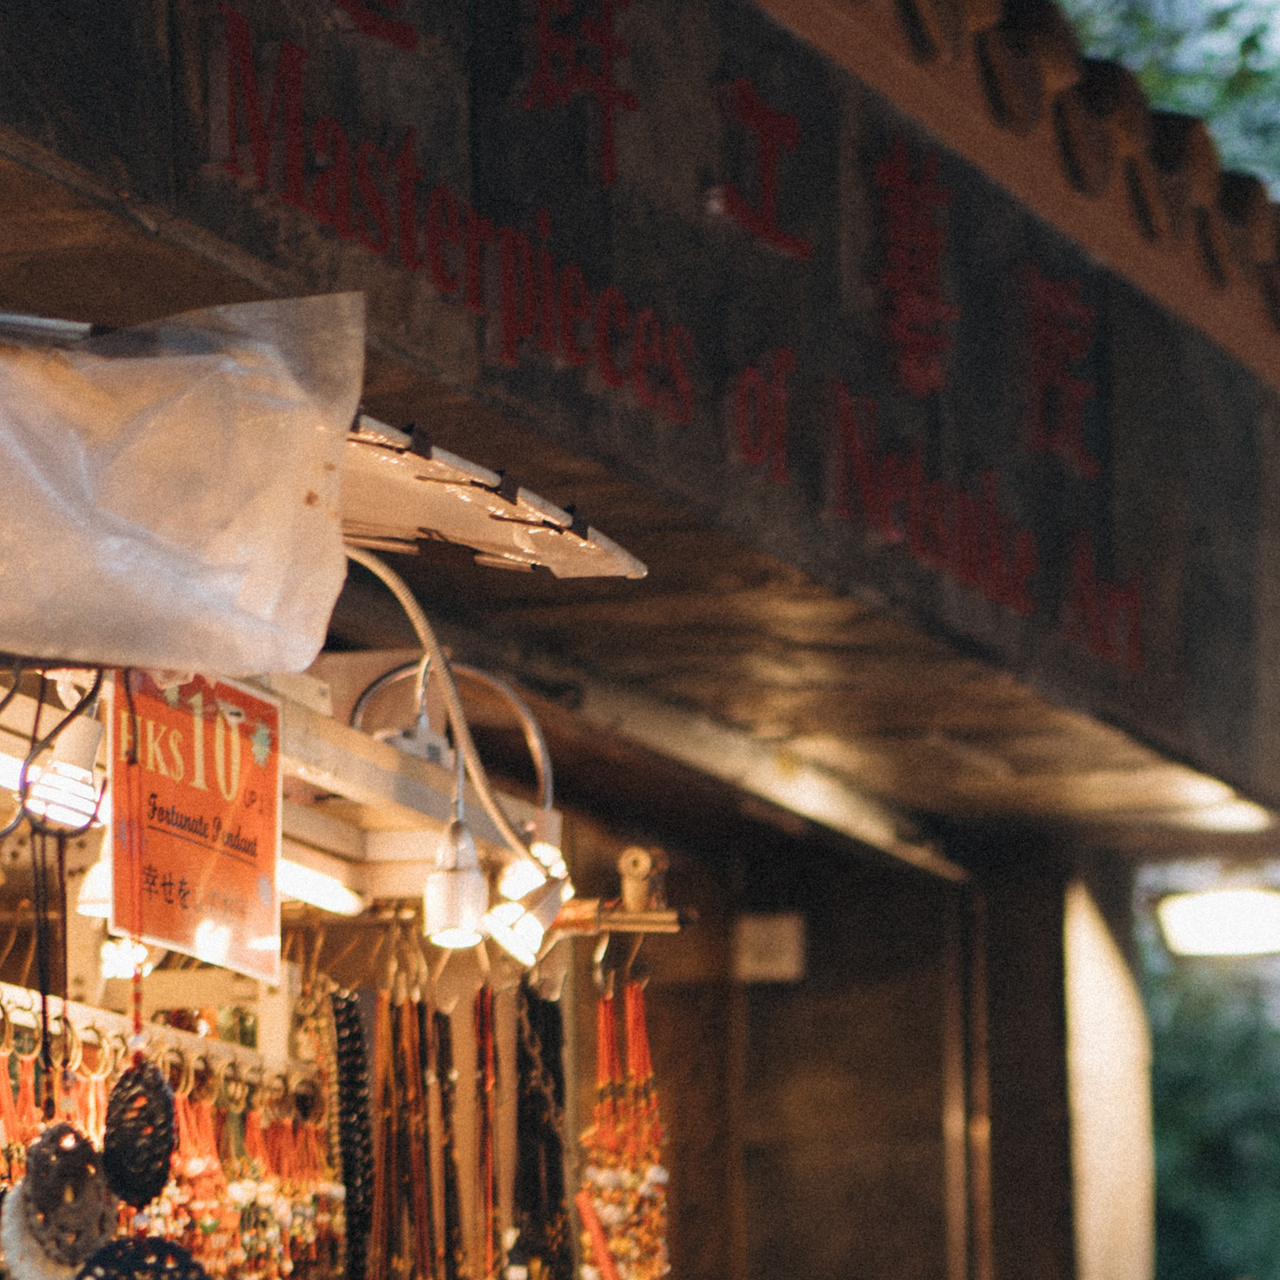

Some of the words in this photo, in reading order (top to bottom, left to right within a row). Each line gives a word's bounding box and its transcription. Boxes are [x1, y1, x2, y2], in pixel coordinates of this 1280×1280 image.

[219, 3, 695, 427] Masterpieces
[734, 346, 797, 485] of
[1066, 528, 1142, 674] Art
[147, 793, 209, 840] Fortunate
